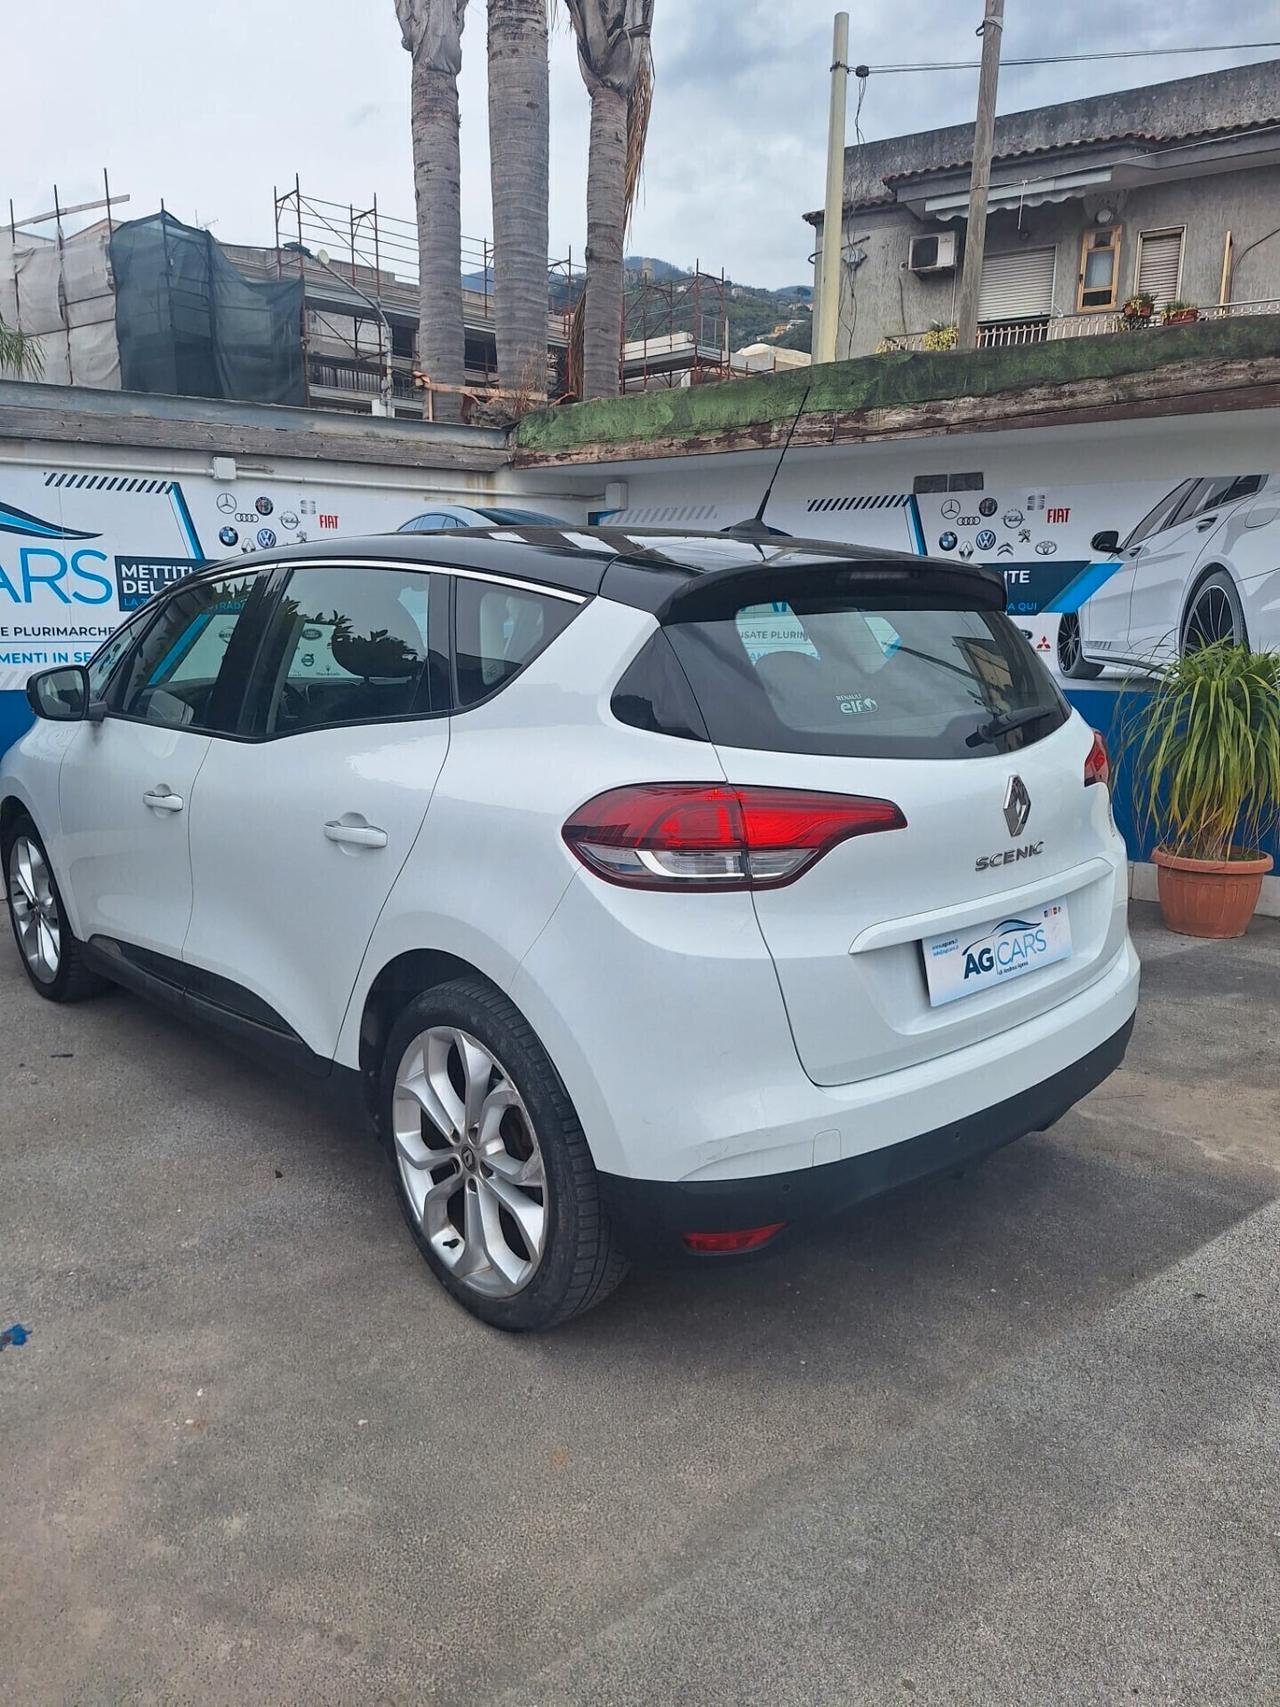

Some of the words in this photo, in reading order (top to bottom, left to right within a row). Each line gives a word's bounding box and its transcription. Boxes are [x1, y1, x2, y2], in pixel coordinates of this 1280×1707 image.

[319, 514, 338, 529] FIAT
[1047, 508, 1071, 523] FIAT
[122, 580, 160, 594] DEL
[1018, 601, 1037, 612] QUI
[53, 652, 68, 663] IN
[840, 700, 862, 713] elf
[975, 841, 1044, 871] SCENIC
[963, 947, 995, 980] AG
[997, 929, 1047, 965] CARS
